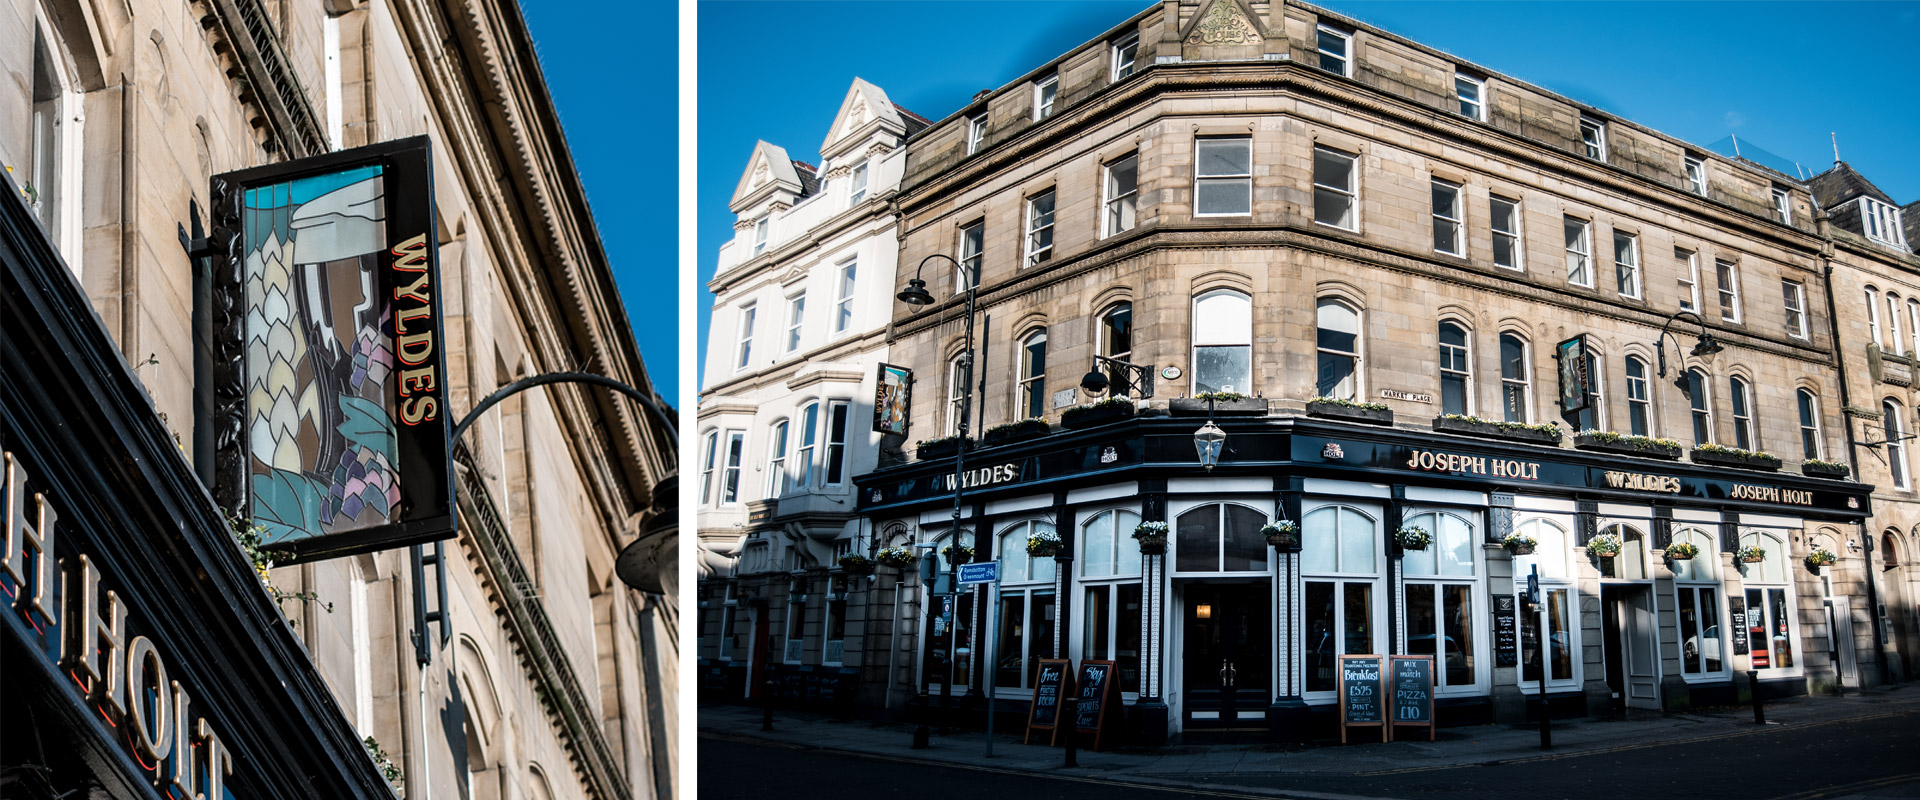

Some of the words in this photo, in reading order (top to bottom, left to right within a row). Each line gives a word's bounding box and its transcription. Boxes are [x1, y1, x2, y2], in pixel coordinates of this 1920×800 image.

[392, 232, 438, 427] WYLDES
[1383, 390, 1408, 399] MARKET
[1412, 394, 1432, 402] PLACE
[1101, 455, 1118, 463] HOLT
[1408, 450, 1486, 476] JOSEPH
[1491, 458, 1541, 480] HOLT
[1604, 470, 1681, 493] WYLDES
[1731, 483, 1780, 502] JOSEPH
[1782, 488, 1813, 505] HOLT
[1040, 667, 1059, 683] Free
[1086, 666, 1105, 687] Sky
[1344, 669, 1379, 681] Breakfast
[1399, 670, 1421, 678] match
[1083, 687, 1098, 698] BT
[1397, 690, 1426, 700] PIZZA
[1076, 700, 1100, 712] SPORTS
[1352, 703, 1370, 711] PINT
[1400, 706, 1420, 720] £10
